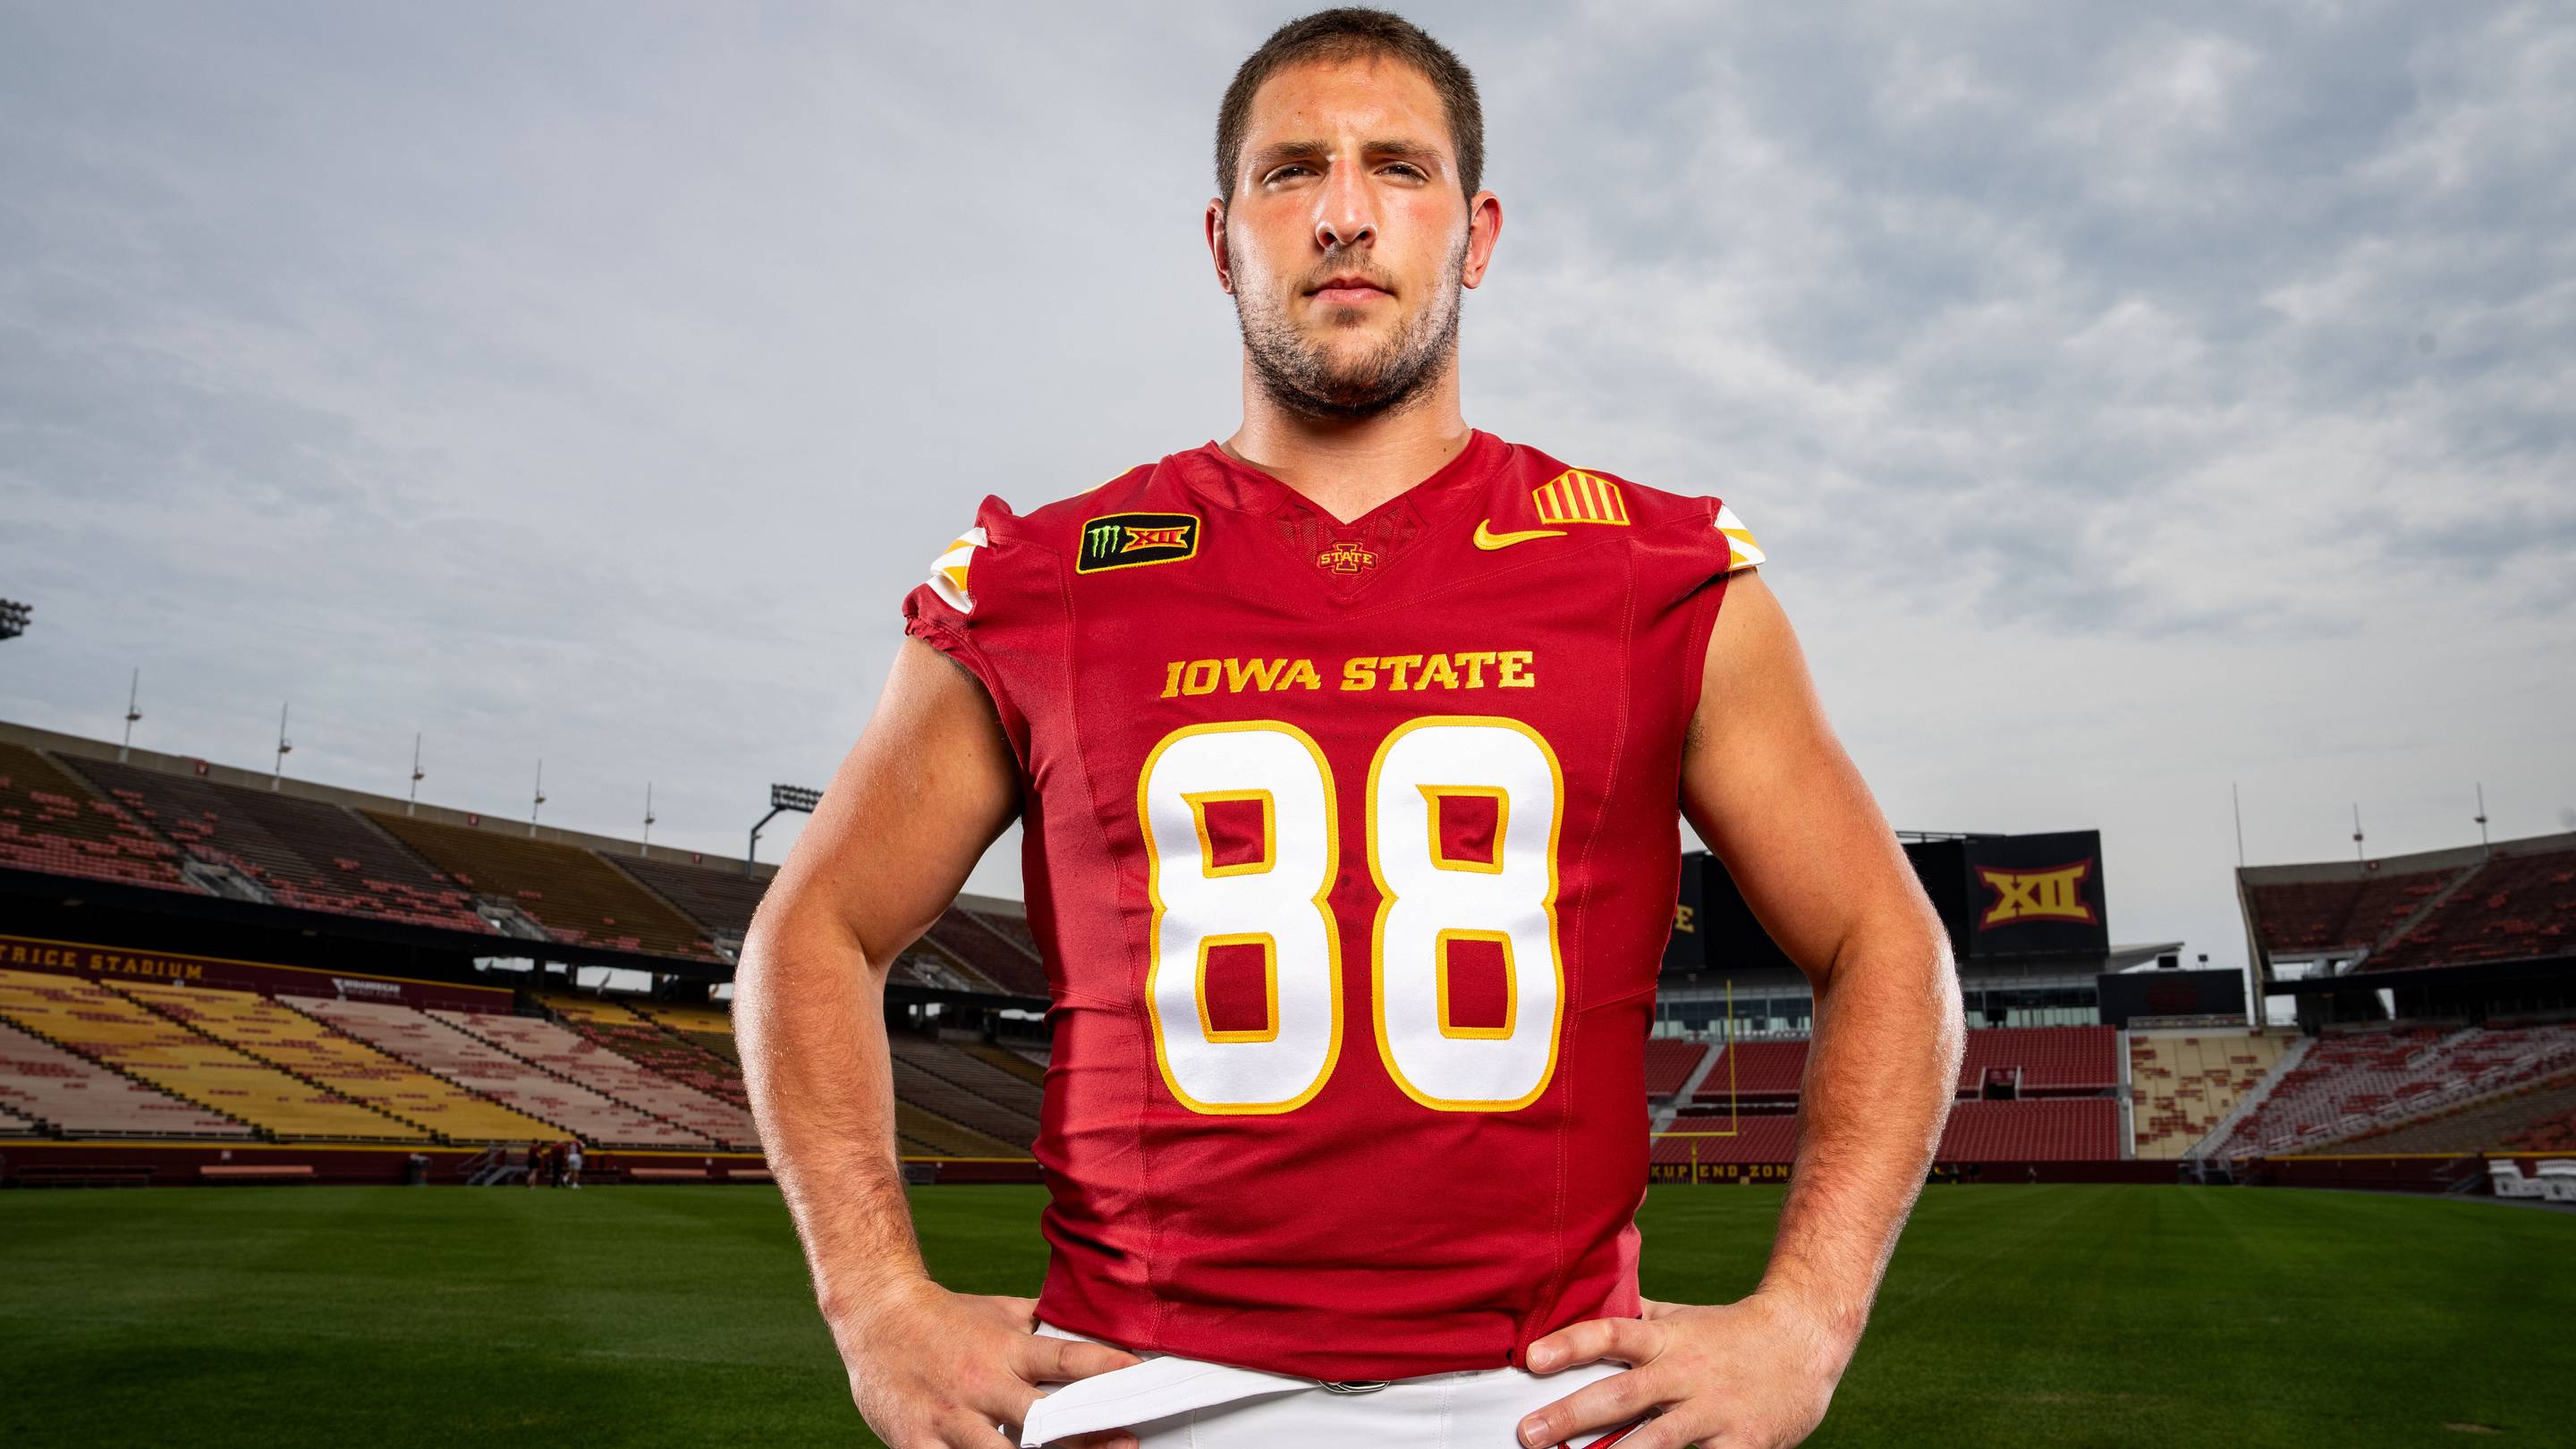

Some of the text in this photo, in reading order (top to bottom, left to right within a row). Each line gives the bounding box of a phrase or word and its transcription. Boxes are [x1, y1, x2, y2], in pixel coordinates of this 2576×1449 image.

[1321, 552, 1372, 564] STATE
[1161, 650, 1535, 698] IOWA STATE
[1980, 863, 2090, 924] XII
[1137, 715, 1565, 1115] 88
[90, 954, 202, 979] STADIUM
[1699, 1165, 1738, 1177] END
[1749, 1165, 1792, 1177] ZON
